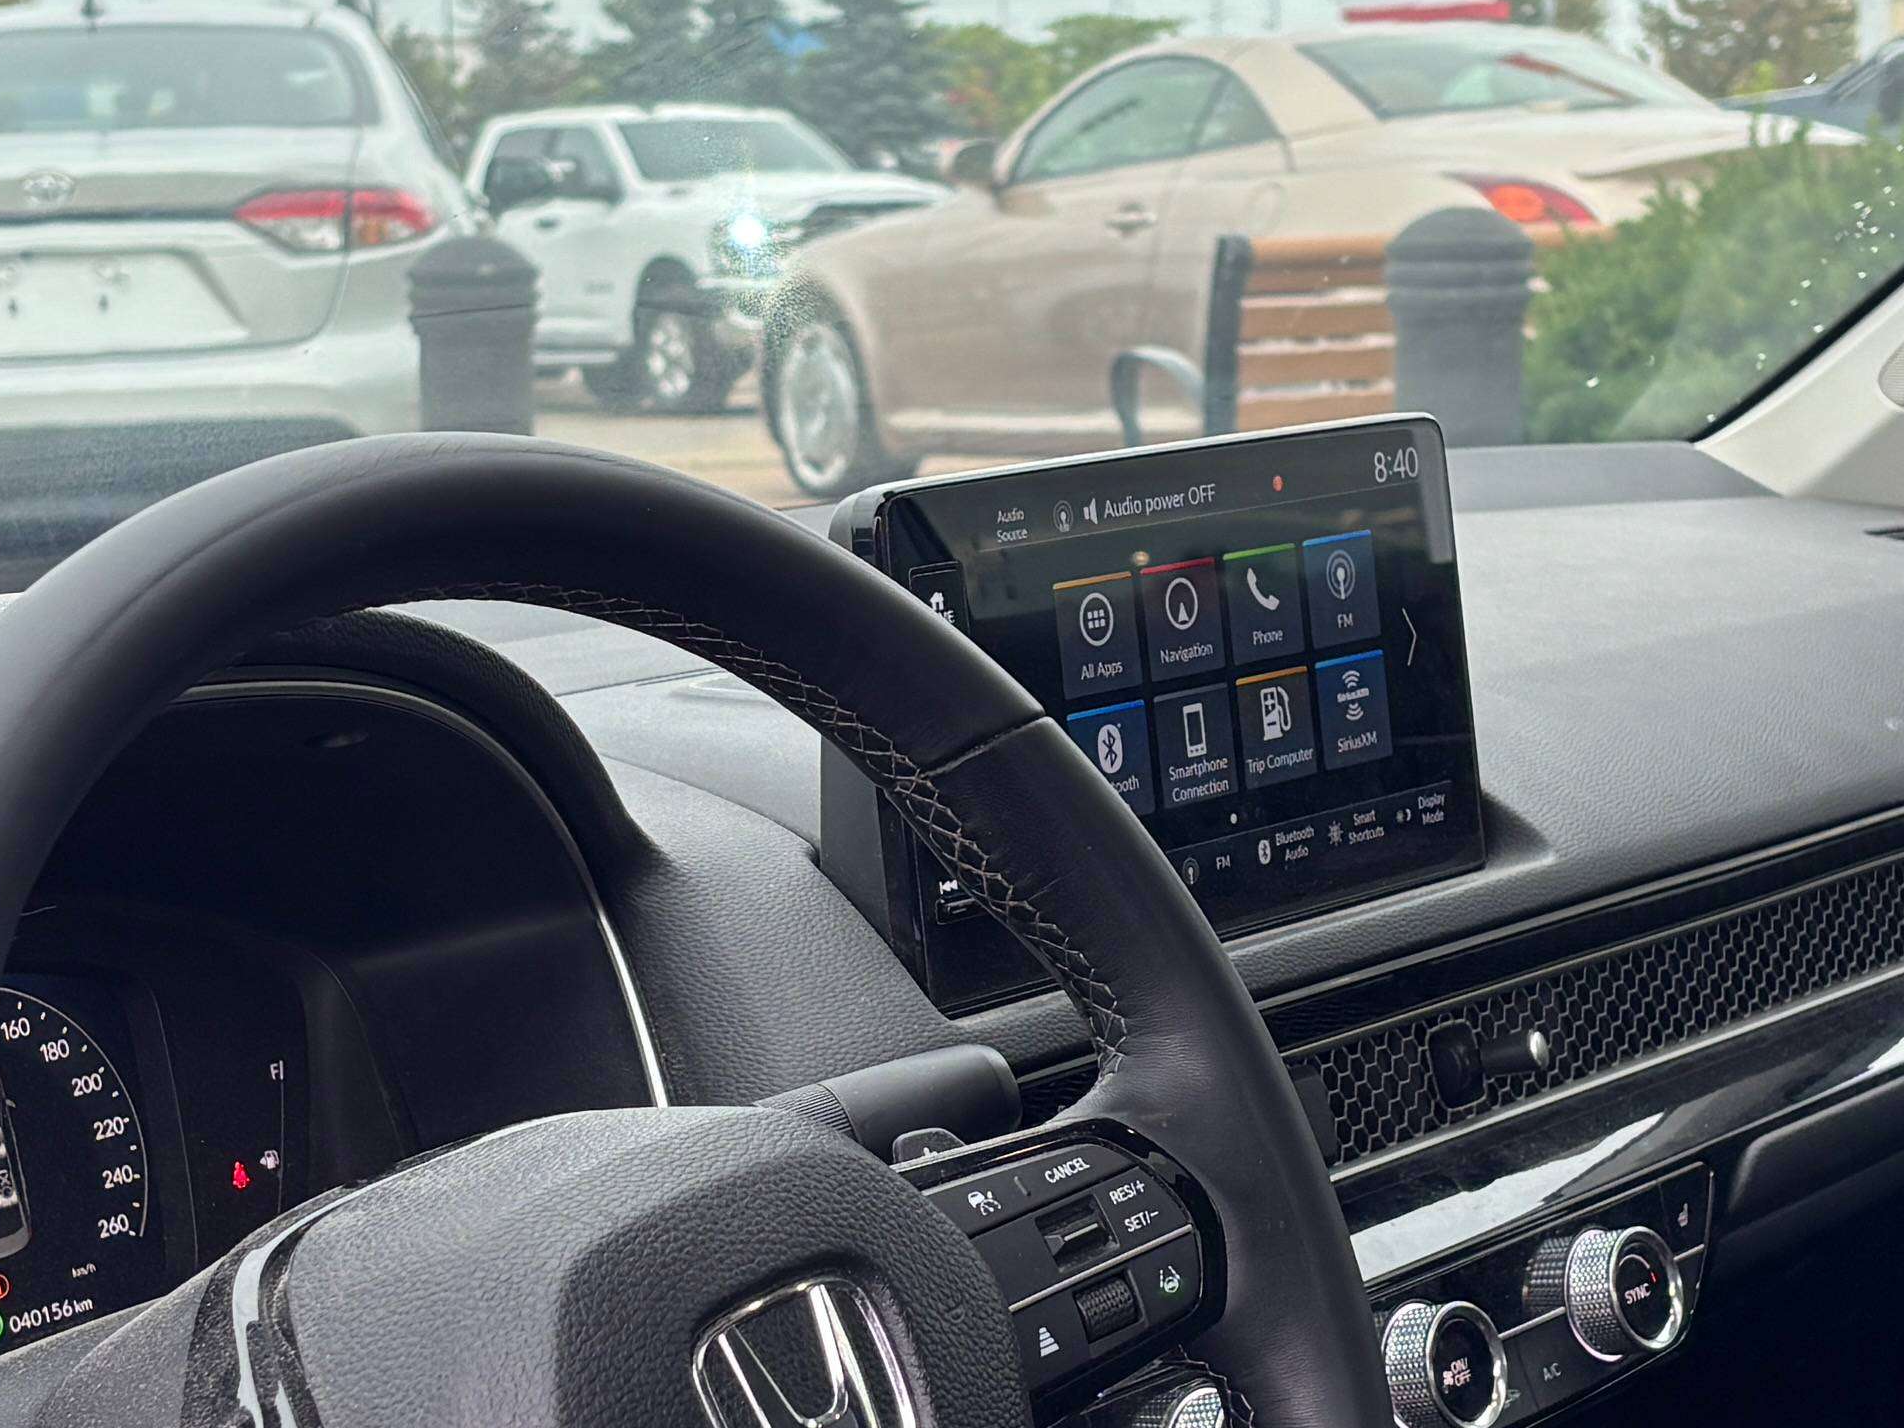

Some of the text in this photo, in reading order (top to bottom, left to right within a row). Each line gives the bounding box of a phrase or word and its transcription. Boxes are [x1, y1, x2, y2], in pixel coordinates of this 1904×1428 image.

[1373, 447, 1419, 483] 8:40
[1104, 484, 1216, 519] Audio power OFF
[997, 508, 1025, 523] Audio
[997, 527, 1028, 543] Source
[1337, 613, 1353, 628] FM
[1253, 627, 1283, 645] Phone
[1160, 641, 1214, 664] Navigation
[1080, 660, 1123, 680] All Apps
[1337, 730, 1378, 754] SiriusXM
[1169, 755, 1229, 781] Smartphone
[1247, 745, 1314, 776] Trip Computer
[1172, 777, 1230, 803] Connection
[1418, 792, 1446, 810] Display
[1353, 810, 1376, 826] Smart
[1421, 809, 1445, 826] Mode
[1275, 825, 1315, 847] Bluetooth
[1348, 825, 1385, 845] Shortcuts
[1216, 854, 1231, 871] FM
[1284, 844, 1309, 863] Audio
[0, 1016, 31, 1042] 160
[39, 1038, 70, 1063] 180
[269, 1062, 279, 1081] F
[71, 1072, 103, 1098] 200
[93, 1116, 125, 1141] 220
[101, 1164, 133, 1190] 240
[1044, 1156, 1091, 1185] CANCEL
[97, 1213, 130, 1240] 260
[1624, 1282, 1653, 1306] SYNC
[9, 1297, 94, 1334] 040156 km
[1449, 1356, 1470, 1375] ON/
[1454, 1368, 1472, 1388] OFF
